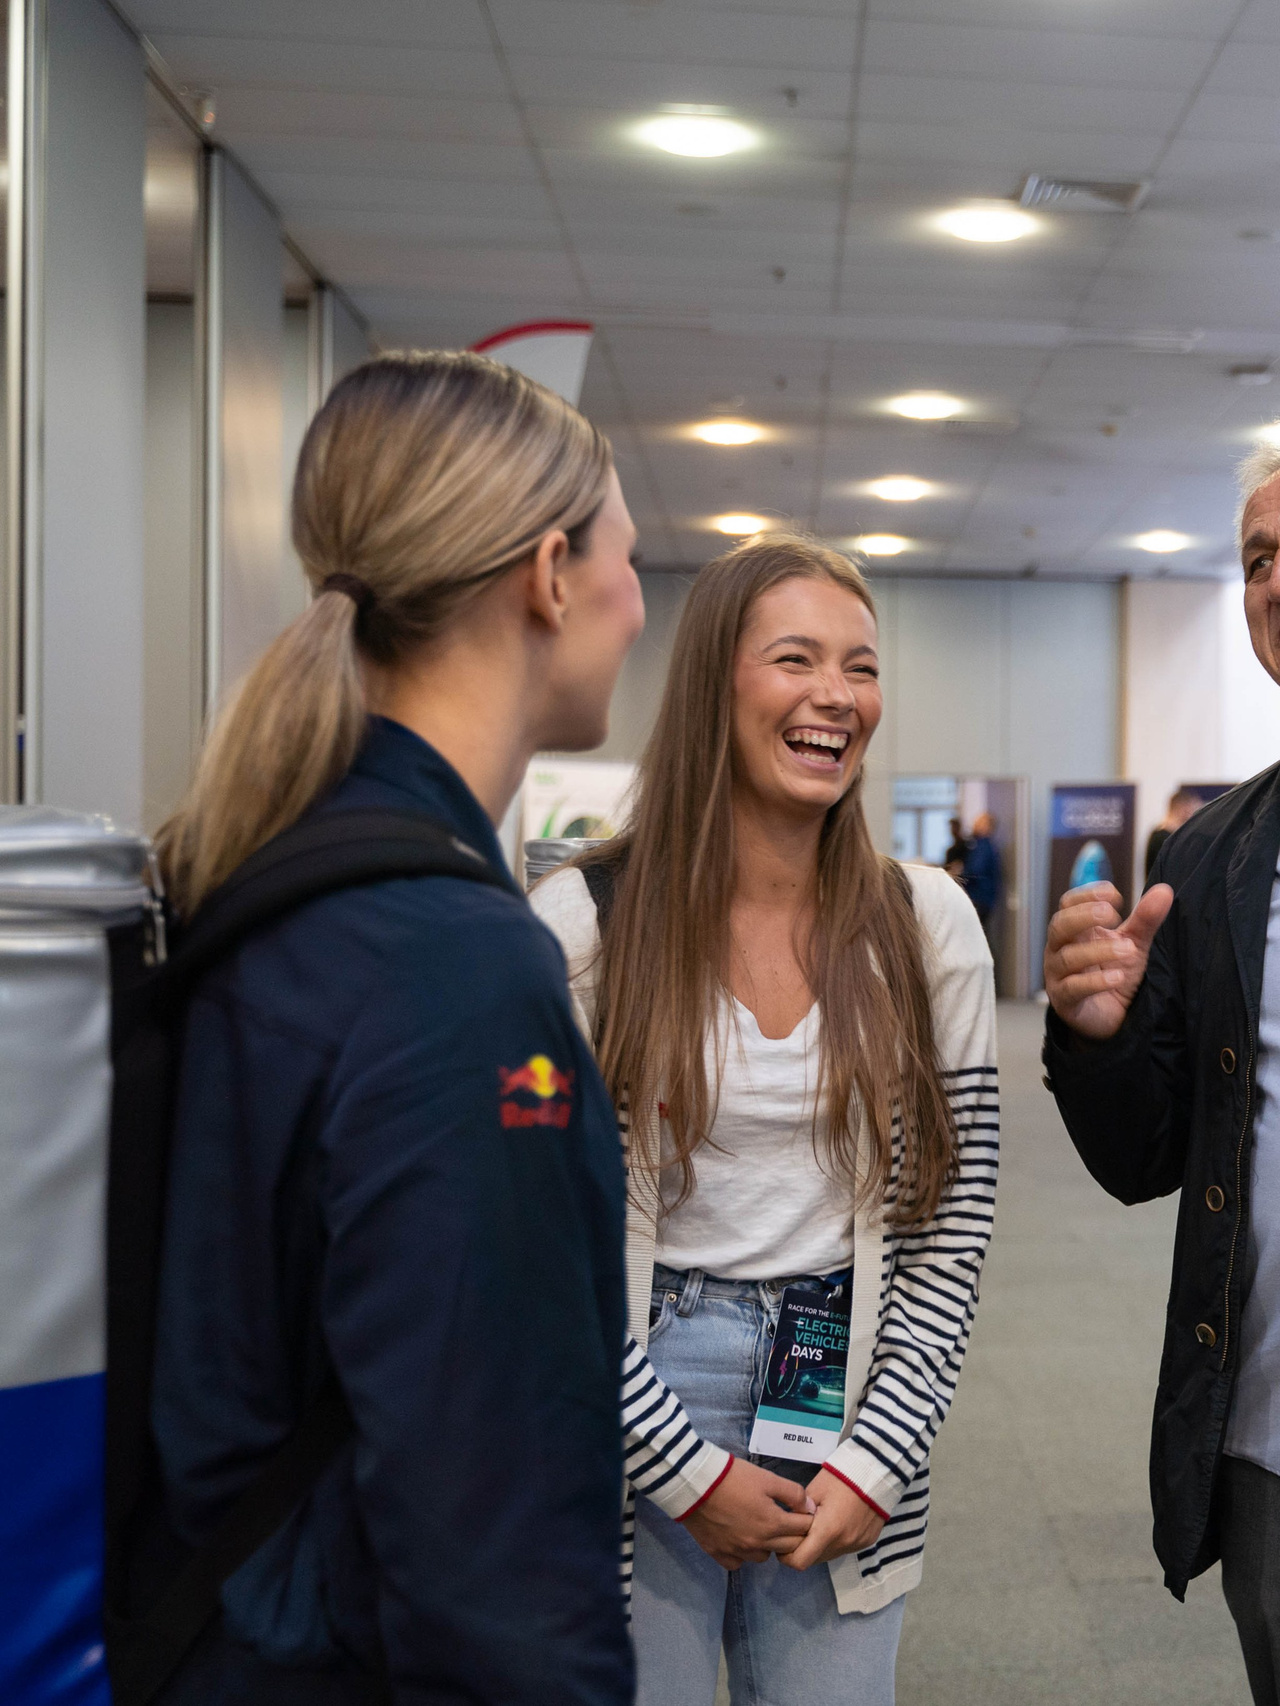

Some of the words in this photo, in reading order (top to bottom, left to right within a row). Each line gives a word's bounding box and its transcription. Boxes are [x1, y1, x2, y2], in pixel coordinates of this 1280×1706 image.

[787, 1303, 804, 1312] RACE
[805, 1307, 817, 1315] FOR
[818, 1310, 830, 1318] THE
[791, 1344, 824, 1361] DAYS
[783, 1433, 797, 1441] RED
[797, 1435, 813, 1444] BULL
